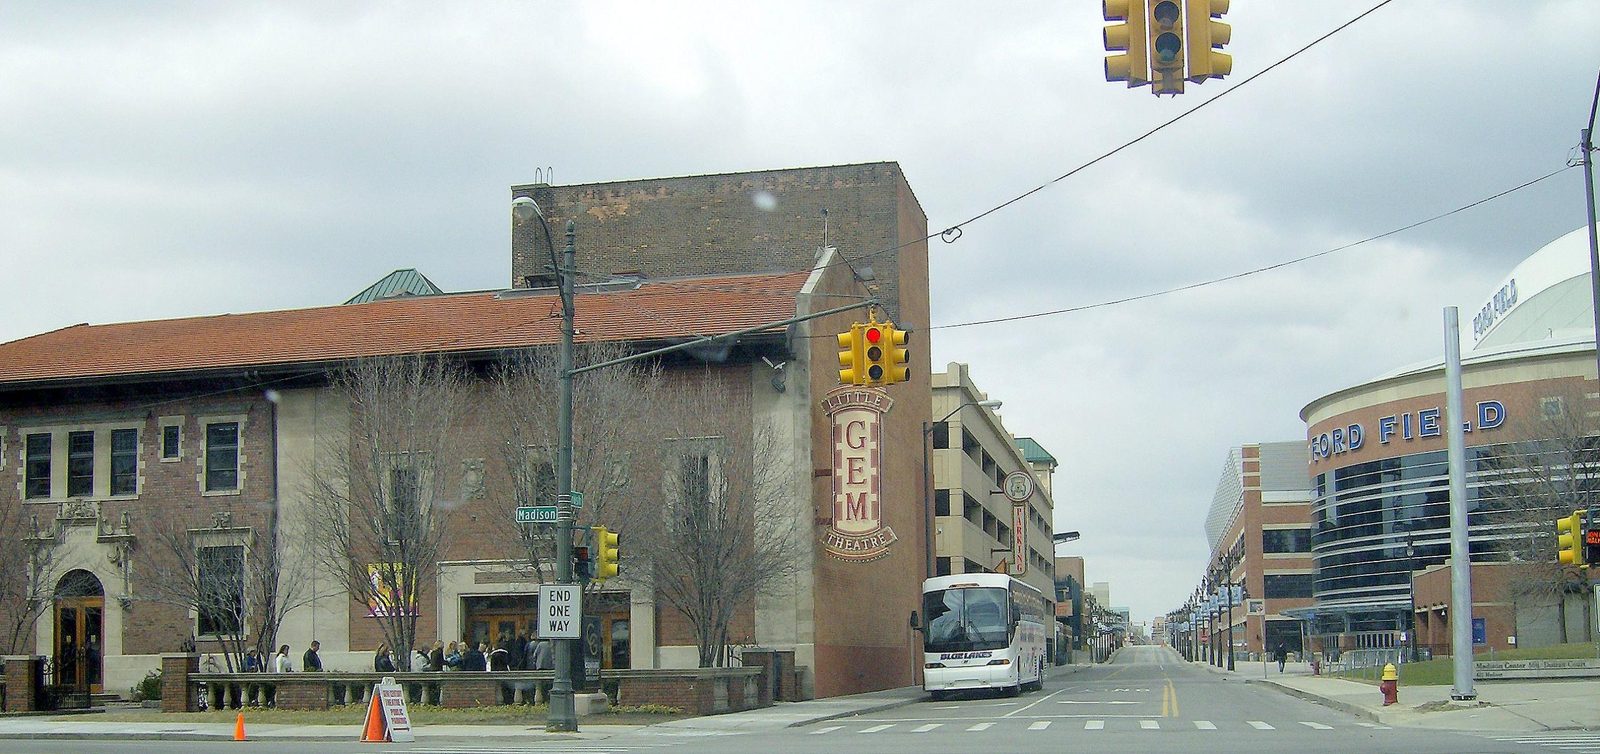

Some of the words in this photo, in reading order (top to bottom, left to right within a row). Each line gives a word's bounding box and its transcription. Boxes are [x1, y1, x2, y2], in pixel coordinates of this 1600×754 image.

[827, 391, 883, 409] LITTLE
[1311, 422, 1366, 462] FORD
[1378, 400, 1506, 444] FIED
[845, 420, 868, 521] GEM
[518, 509, 556, 520] Madison
[827, 533, 887, 551] THEATRE
[549, 590, 571, 602] END
[549, 605, 570, 617] ONE
[549, 620, 570, 632] WAY
[964, 651, 993, 660] LAKES
